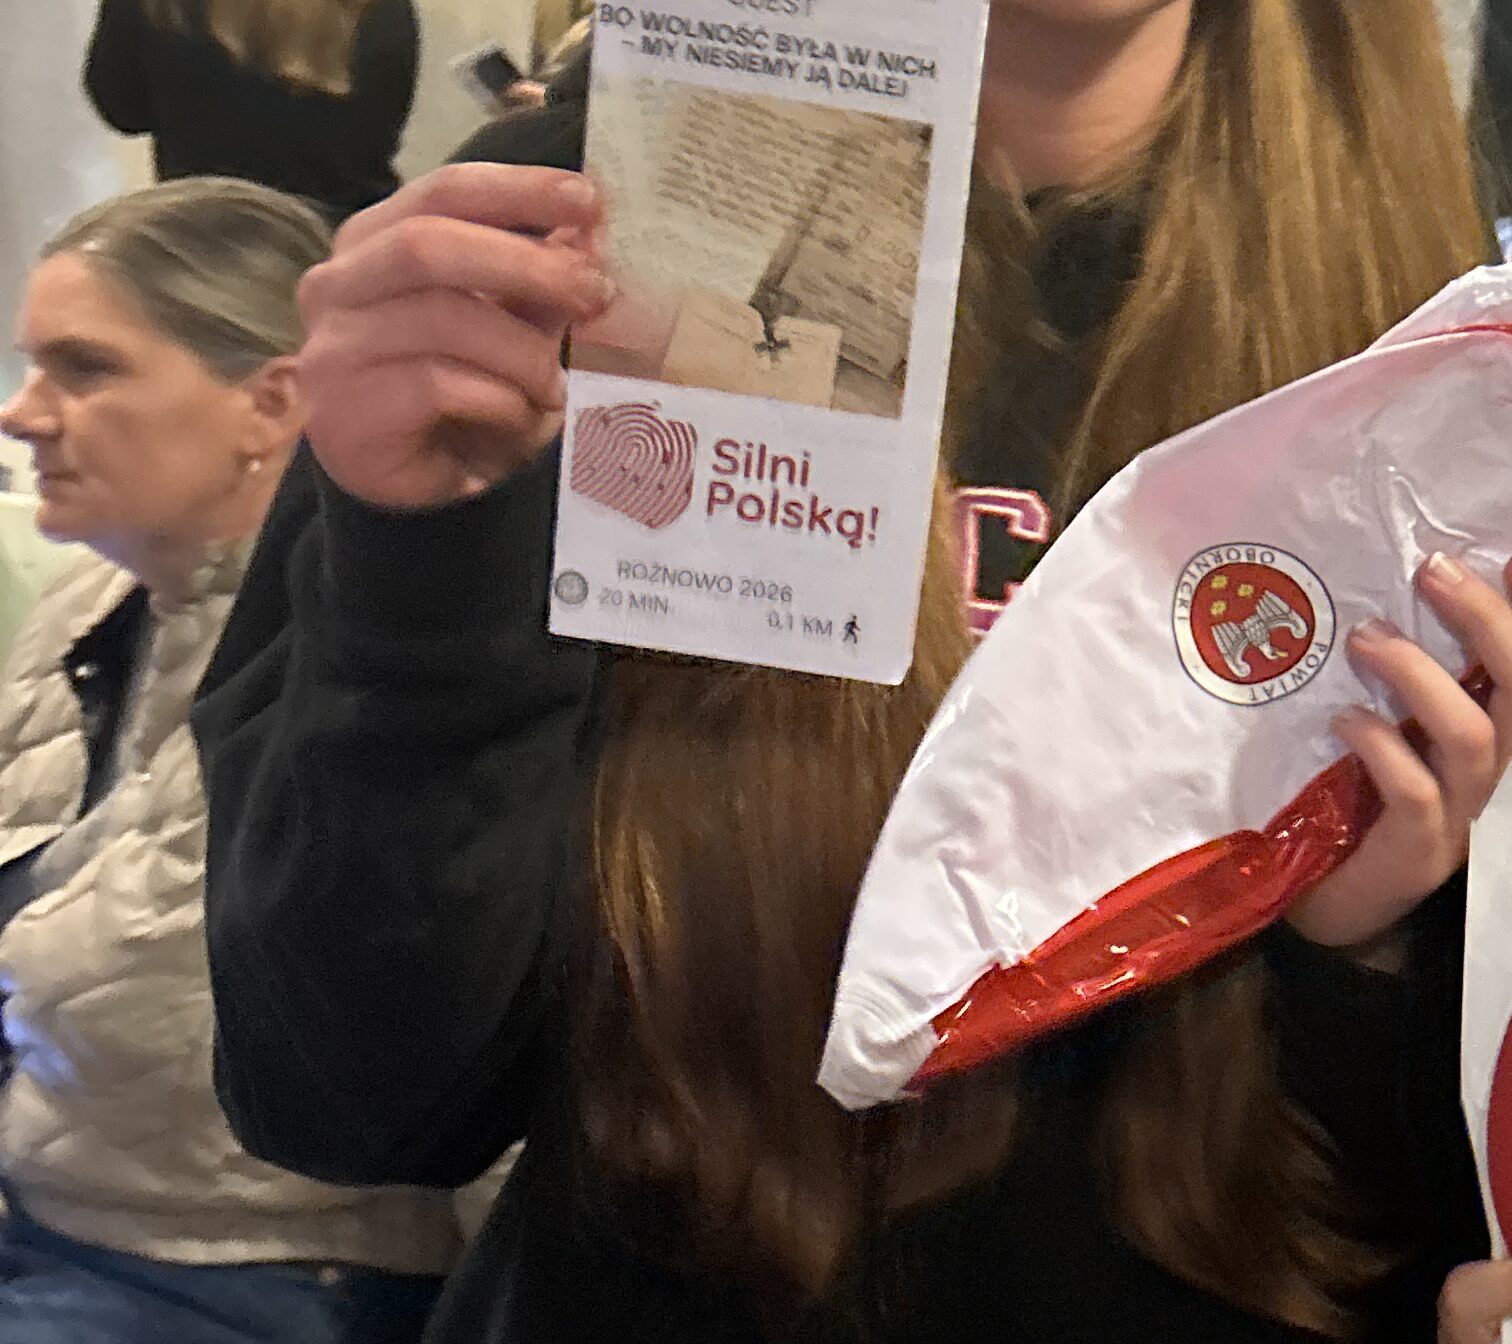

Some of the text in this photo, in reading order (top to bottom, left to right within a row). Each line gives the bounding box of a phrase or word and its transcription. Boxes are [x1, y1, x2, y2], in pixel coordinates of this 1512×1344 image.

[600, 3, 937, 79] BO WOLNOŚĆ BYŁA W NICH
[640, 34, 679, 58] MY
[686, 43, 800, 78] NIESIEMY
[804, 57, 832, 92] JĄ
[838, 68, 908, 98] DALEJ
[712, 437, 812, 488] Silni
[706, 480, 879, 549] Polską!
[738, 578, 793, 603] 2026
[1177, 547, 1275, 621] OBORNICKI
[802, 617, 833, 637] KM
[1249, 641, 1328, 702] POWIAT
